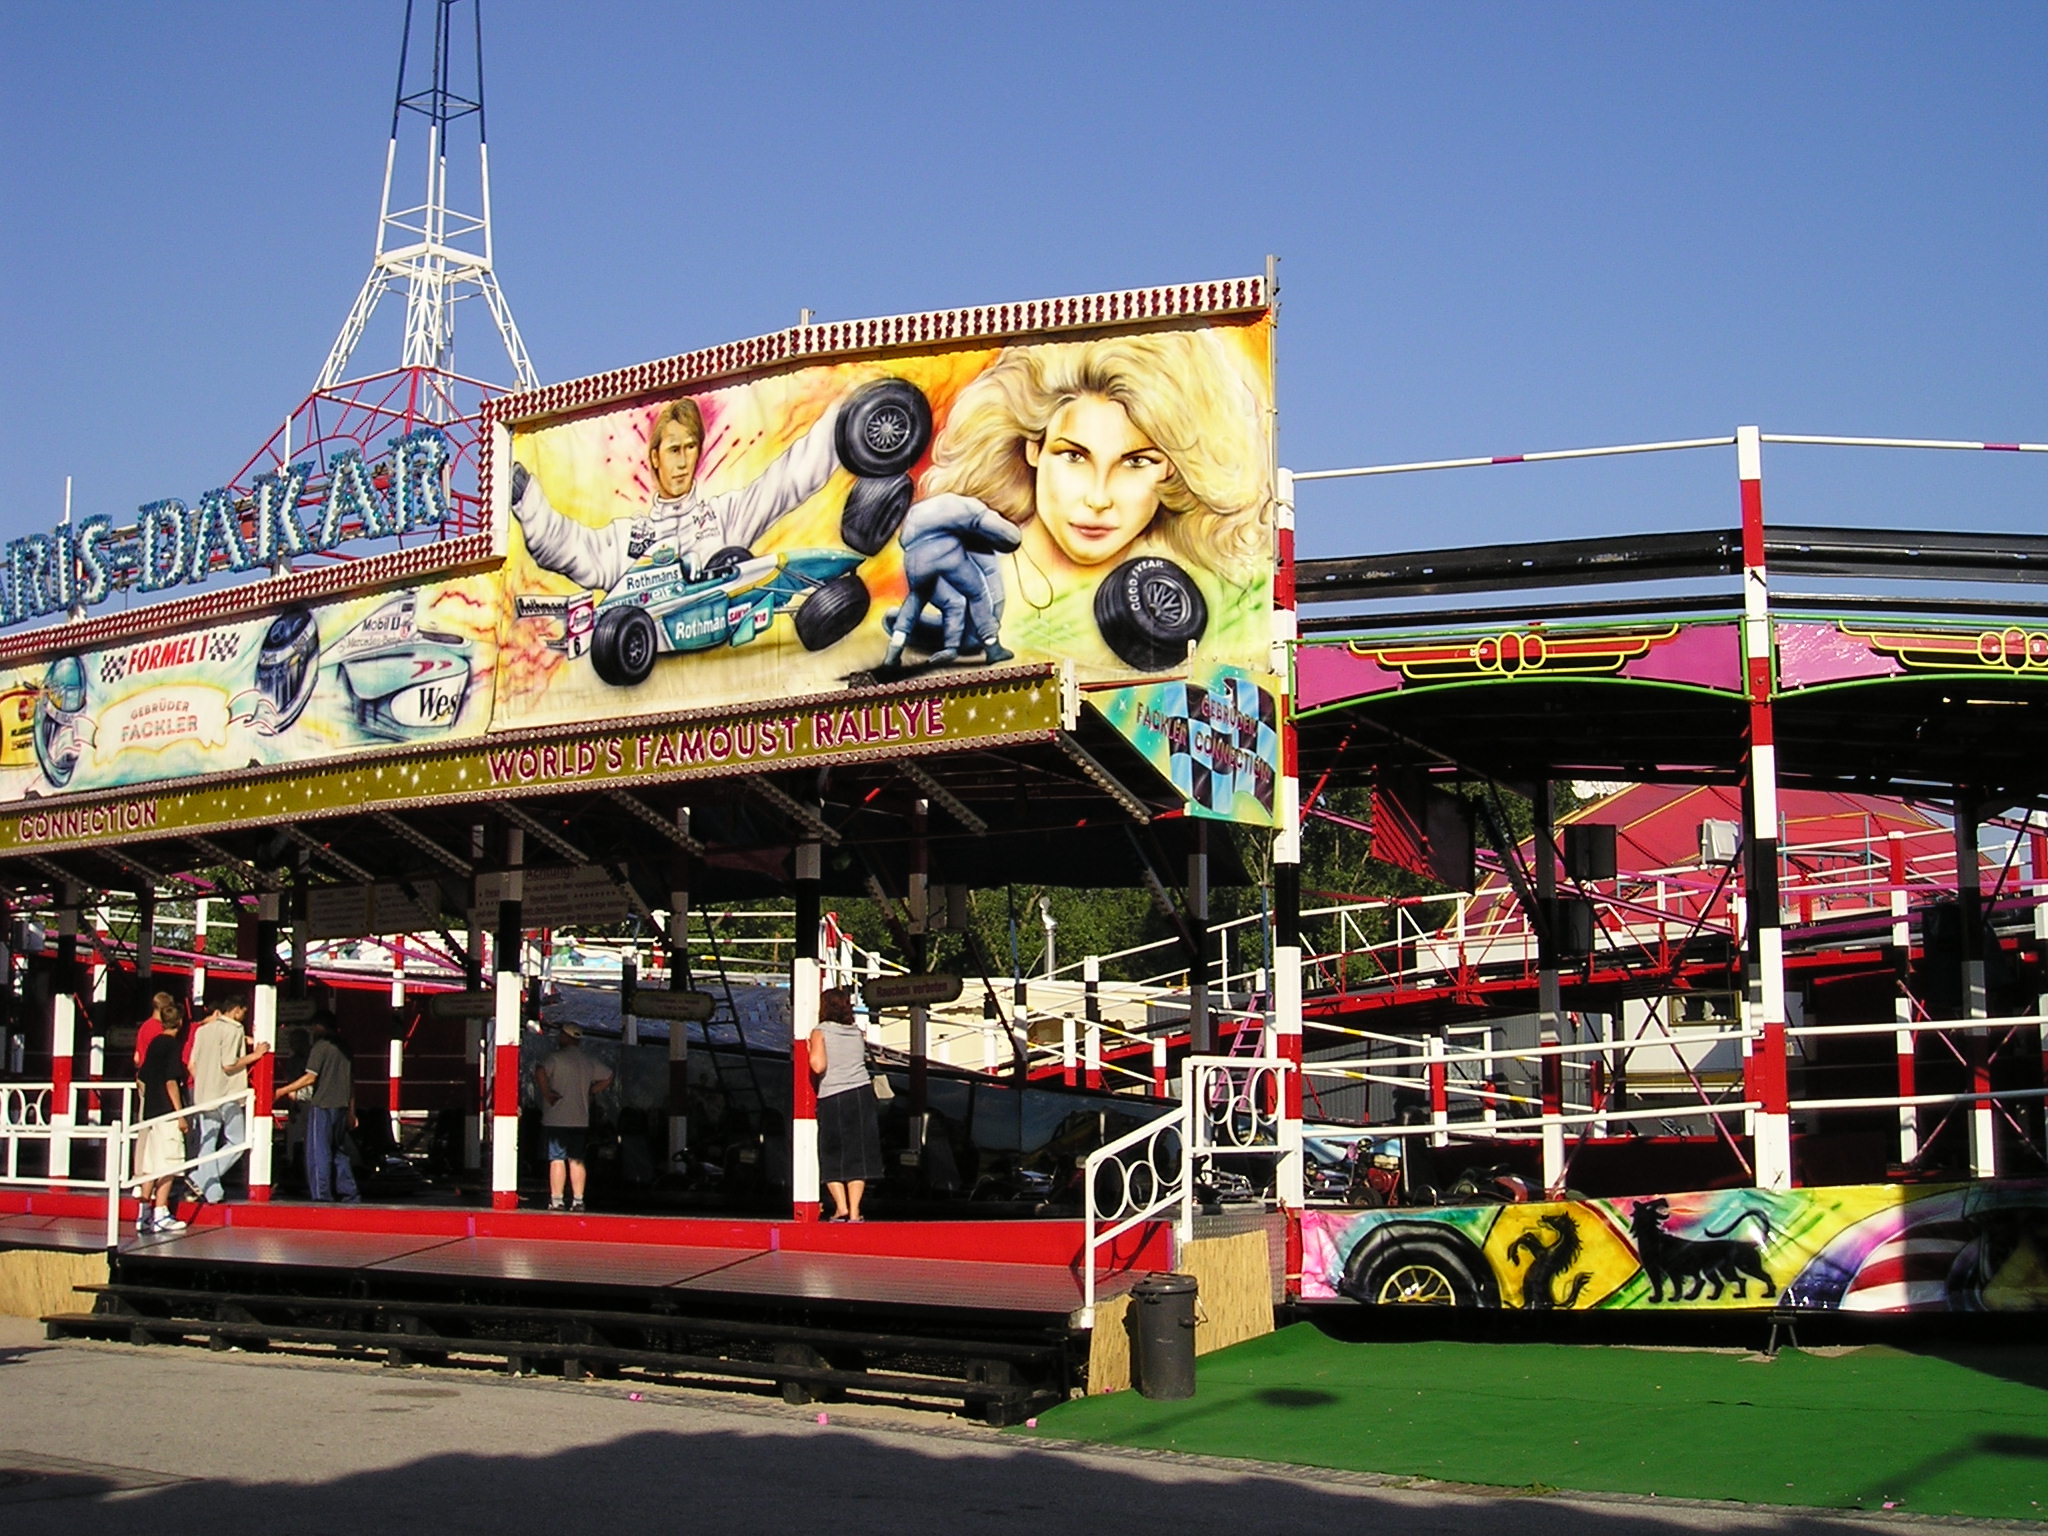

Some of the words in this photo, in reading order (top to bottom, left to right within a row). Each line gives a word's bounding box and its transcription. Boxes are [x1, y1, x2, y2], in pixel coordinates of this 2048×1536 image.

[627, 569, 679, 590] Rothmans
[362, 616, 390, 631] Mobil
[127, 637, 196, 675] FORMEL
[199, 634, 209, 661] 1
[130, 697, 189, 720] GEBRÜDER
[419, 687, 461, 719] Wes
[1201, 694, 1258, 737] GEBRÜDER
[121, 715, 198, 743] FACKLER
[488, 736, 623, 785] WORLD'S
[636, 715, 799, 770] FAMOUST
[812, 697, 945, 749] RALLYE
[1137, 702, 1188, 746] FACKLER
[1195, 731, 1272, 782] CONNECTION
[19, 797, 158, 842] CONNECTION
